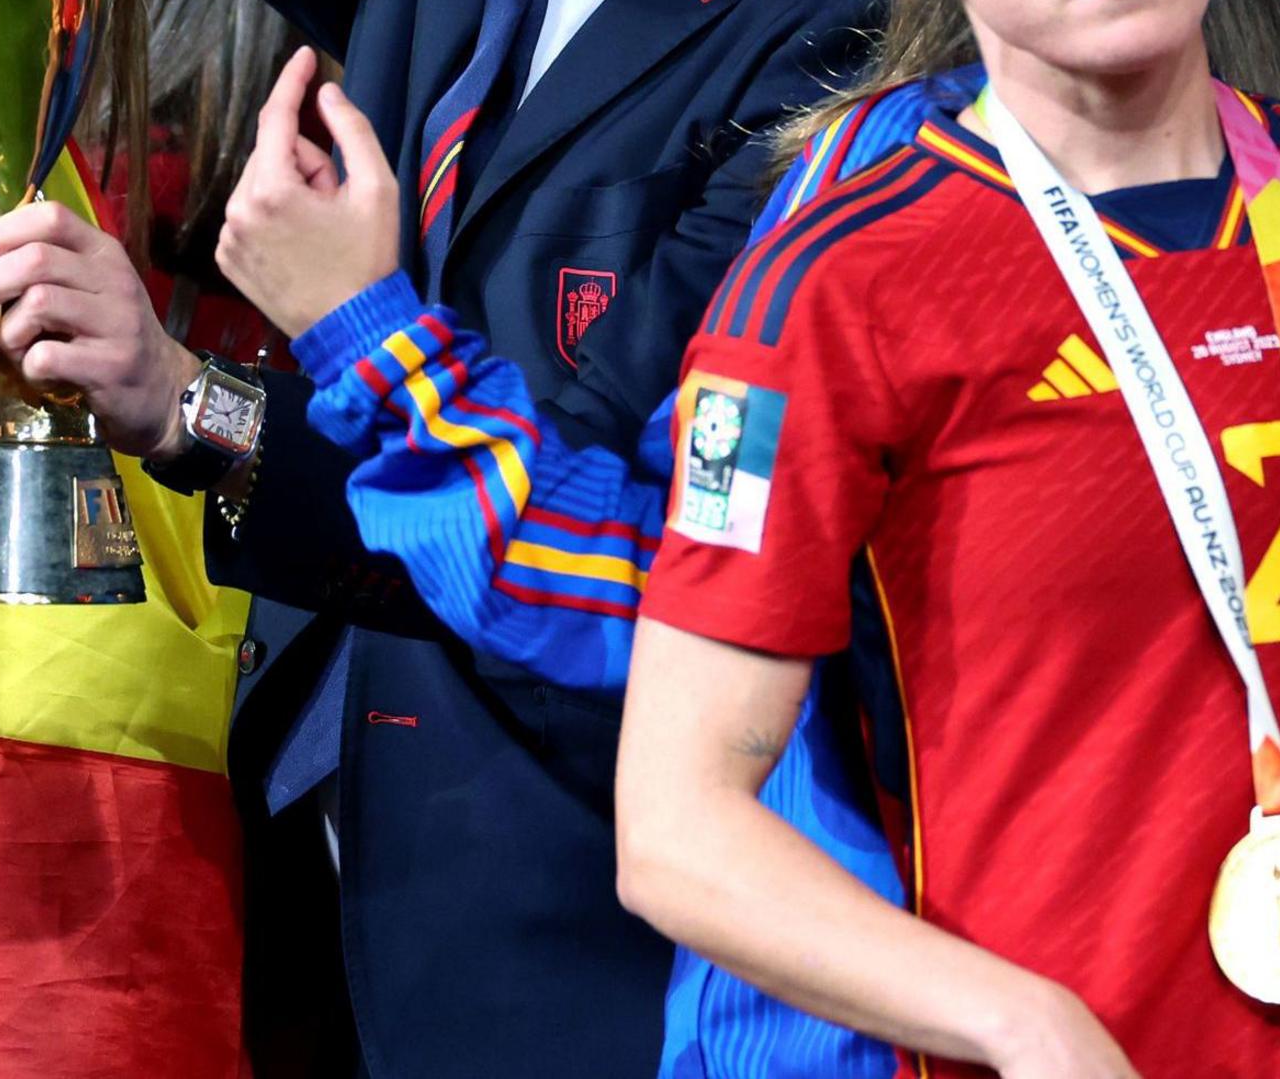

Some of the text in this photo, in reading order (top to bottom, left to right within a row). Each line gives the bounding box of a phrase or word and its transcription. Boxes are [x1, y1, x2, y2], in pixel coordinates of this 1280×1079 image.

[1043, 185, 1080, 235] FIFA
[1070, 233, 1137, 341] WOMEN'S
[1126, 344, 1176, 428] WORLD
[1165, 431, 1197, 481] CUP
